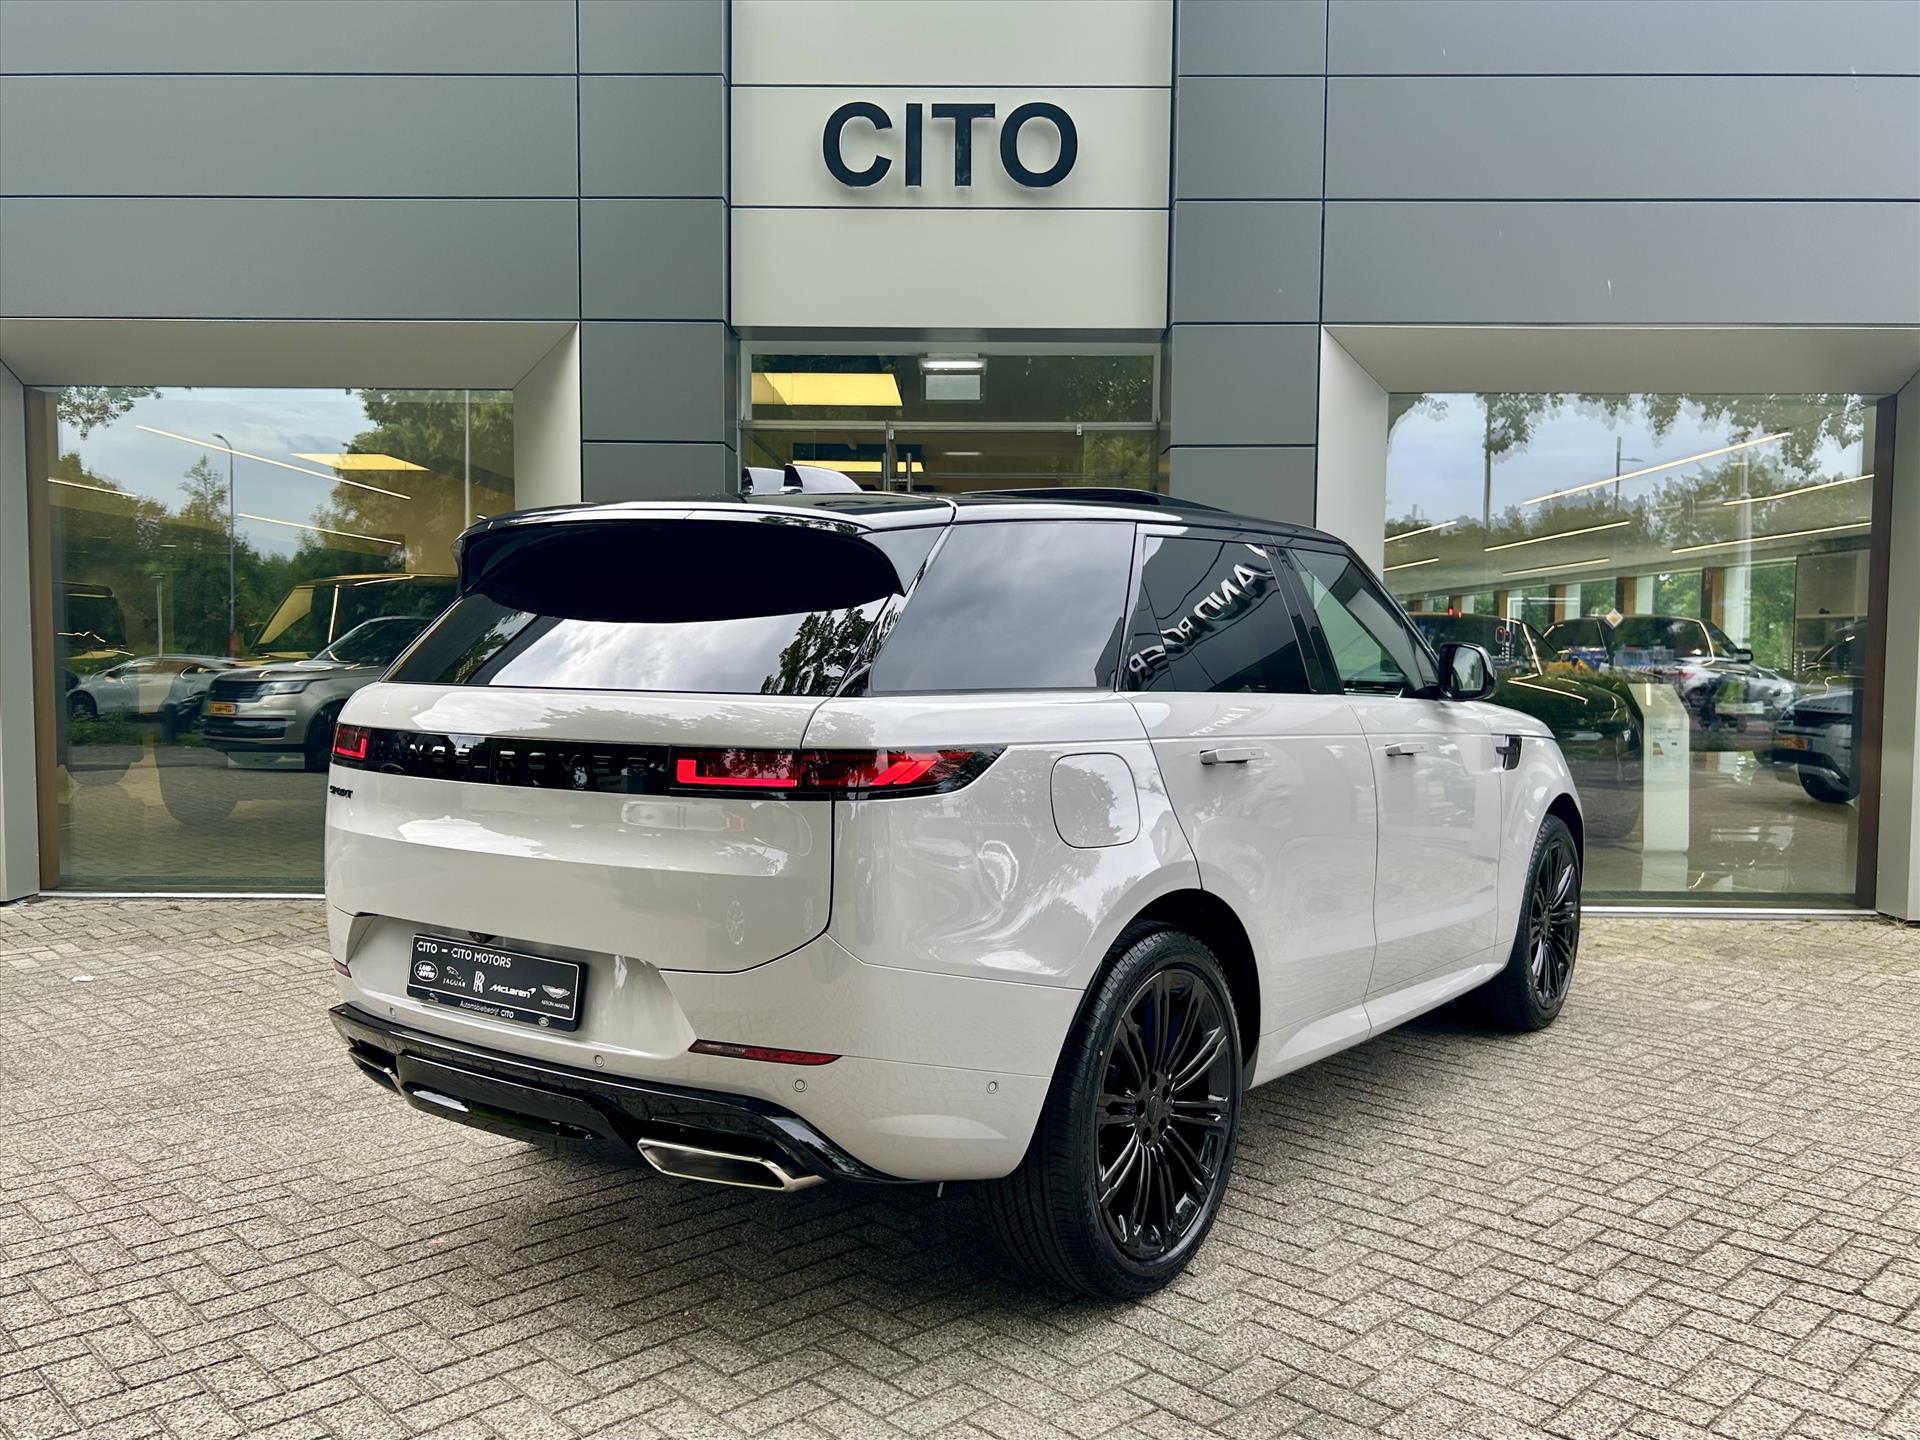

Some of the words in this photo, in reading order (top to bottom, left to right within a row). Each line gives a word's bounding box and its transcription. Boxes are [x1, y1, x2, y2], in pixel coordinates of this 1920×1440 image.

[822, 101, 1078, 188] CITO
[416, 941, 438, 954] CITO
[450, 947, 472, 961] CITO
[473, 951, 512, 969] MOTORS
[442, 977, 466, 988] JAGUAR
[489, 983, 532, 999] McLaren
[500, 1008, 515, 1019] CITO
